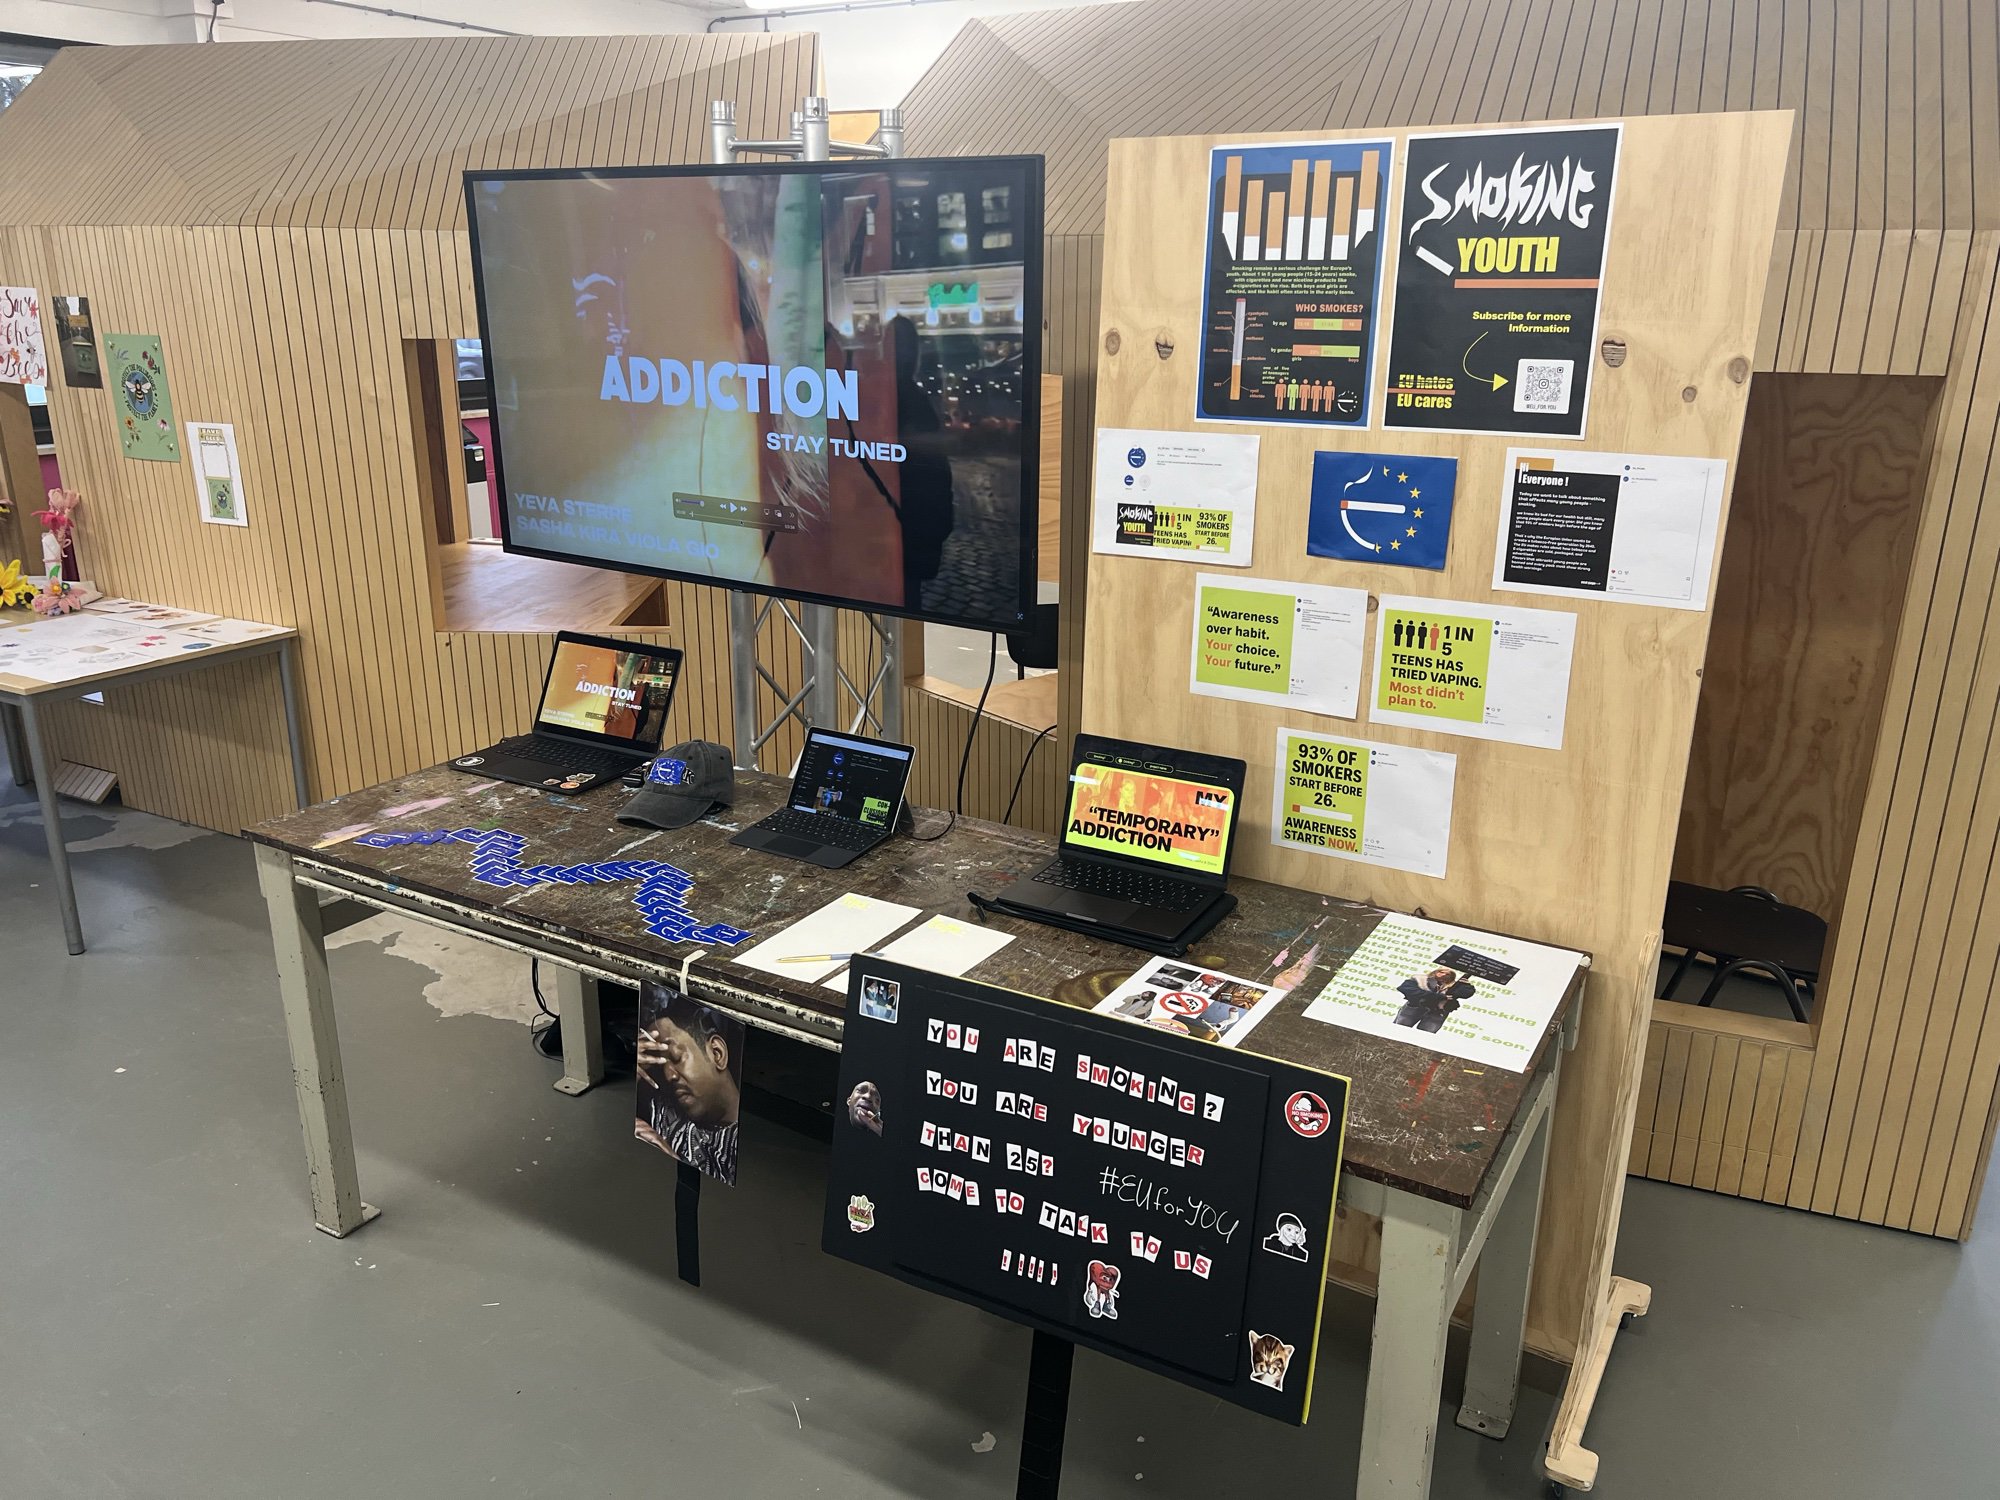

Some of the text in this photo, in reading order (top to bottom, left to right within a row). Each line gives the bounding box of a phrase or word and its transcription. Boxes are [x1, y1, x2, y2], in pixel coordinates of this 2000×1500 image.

[1408, 151, 1596, 245] SMOKING
[1457, 236, 1560, 274] YOUTH
[1295, 303, 1364, 313] WHO SMOKES?
[1472, 311, 1572, 321] Subscribe for more
[1508, 323, 1570, 333] Information
[600, 355, 860, 421] ADDICTION
[1398, 374, 1454, 390] EU hates
[1397, 394, 1452, 409] EU cares
[766, 432, 907, 463] STAY TUNED
[1522, 474, 1564, 486] Everyone
[515, 493, 633, 523] YEVA STERRE
[1176, 513, 1192, 522] 1 IN
[1199, 512, 1228, 522] 93% OF
[1123, 521, 1146, 533] YOUTH
[1174, 531, 1187, 539] HAS
[1176, 522, 1182, 530] 5
[1196, 521, 1230, 531] SMOKERS
[516, 515, 720, 559] SASHA KIRA VIOLA GIO
[1206, 537, 1217, 545] 26.
[1207, 606, 1279, 625] “Awareness
[1206, 625, 1270, 640] over habit.
[1443, 625, 1474, 642] 1 IN
[1206, 639, 1280, 658] Your choice.
[1441, 642, 1453, 656] 5
[1205, 655, 1281, 674] Your future.”
[1392, 653, 1464, 672] TEENS HAS
[1390, 667, 1482, 689] TRIED VAPING.
[575, 680, 637, 702] ADDICTION
[1389, 681, 1423, 696] Most
[611, 700, 642, 711] STAY TUNED
[1387, 694, 1437, 710] plan to.
[1298, 743, 1358, 766] 93% OF
[1292, 759, 1362, 783] SMOKERS
[1289, 776, 1363, 797] START BEFORE
[1195, 790, 1228, 808] MY
[1313, 792, 1337, 808] 26.
[1089, 805, 1220, 842] “TEMPORARY”
[1284, 816, 1357, 839] AWARENESS
[1069, 819, 1172, 853] ADDICTION
[1284, 829, 1325, 846] STARTS
[1327, 837, 1358, 853] NOW.
[1375, 928, 1410, 940] start
[1414, 937, 1433, 945] as
[1379, 921, 1445, 941] Smoking
[1364, 940, 1432, 960] starts as
[1336, 990, 1372, 1002] new
[1462, 1003, 1537, 1027] smoking
[929, 1022, 979, 1047] YOU
[1004, 1043, 1054, 1070] ARE
[1481, 1035, 1530, 1052] soon.
[927, 1075, 1203, 1164] YOU ARE YOUNGER
[1300, 1111, 1324, 1119] SMOKING
[925, 1126, 1053, 1175] THAN 25?
[919, 1170, 1210, 1274] COME TO TALK TO US
